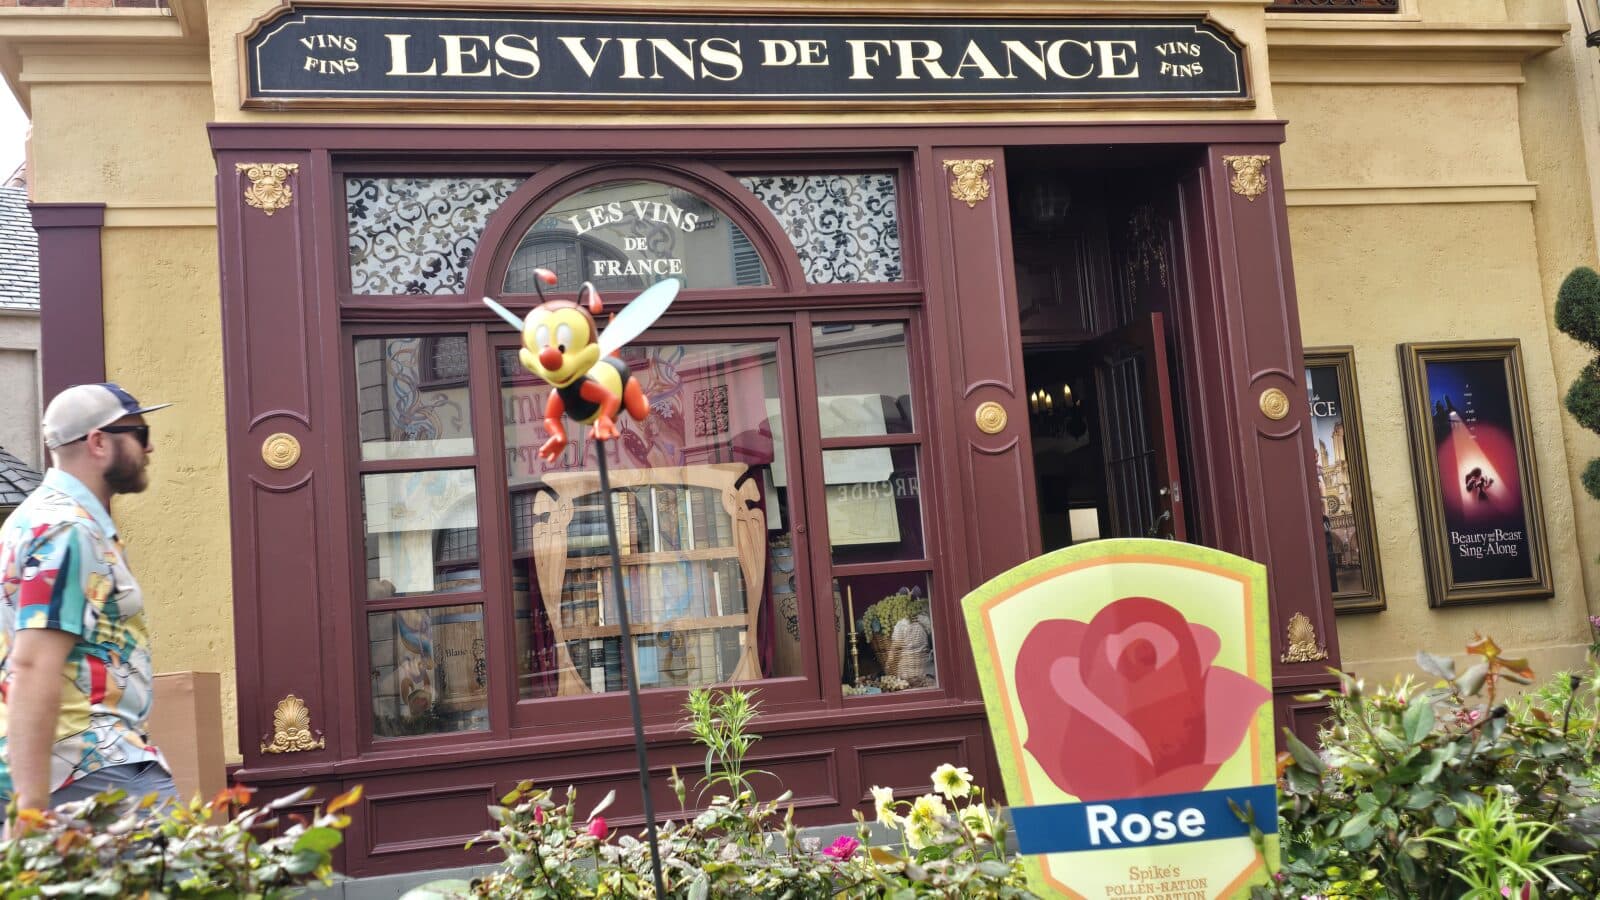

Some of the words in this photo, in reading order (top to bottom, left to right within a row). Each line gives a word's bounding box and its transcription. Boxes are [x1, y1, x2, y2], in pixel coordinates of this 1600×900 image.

[299, 34, 358, 52] VINS
[1155, 42, 1201, 57] VINS
[303, 56, 360, 75] FINS
[384, 33, 541, 79] LES
[556, 36, 744, 81] VINS
[758, 39, 830, 66] DE
[846, 39, 1139, 80] FRANCE
[1160, 61, 1204, 77] FINS
[568, 202, 624, 236] LES
[630, 200, 700, 232] VINS
[624, 237, 648, 251] DE
[593, 259, 683, 276] FRANCE
[1451, 531, 1487, 546] Beauty
[1494, 529, 1523, 542] Beast
[1459, 541, 1518, 559] Sing-Along
[1086, 804, 1206, 845] Rose
[1129, 865, 1181, 882] Spike's
[1105, 878, 1208, 896] POLLEN-NATION
